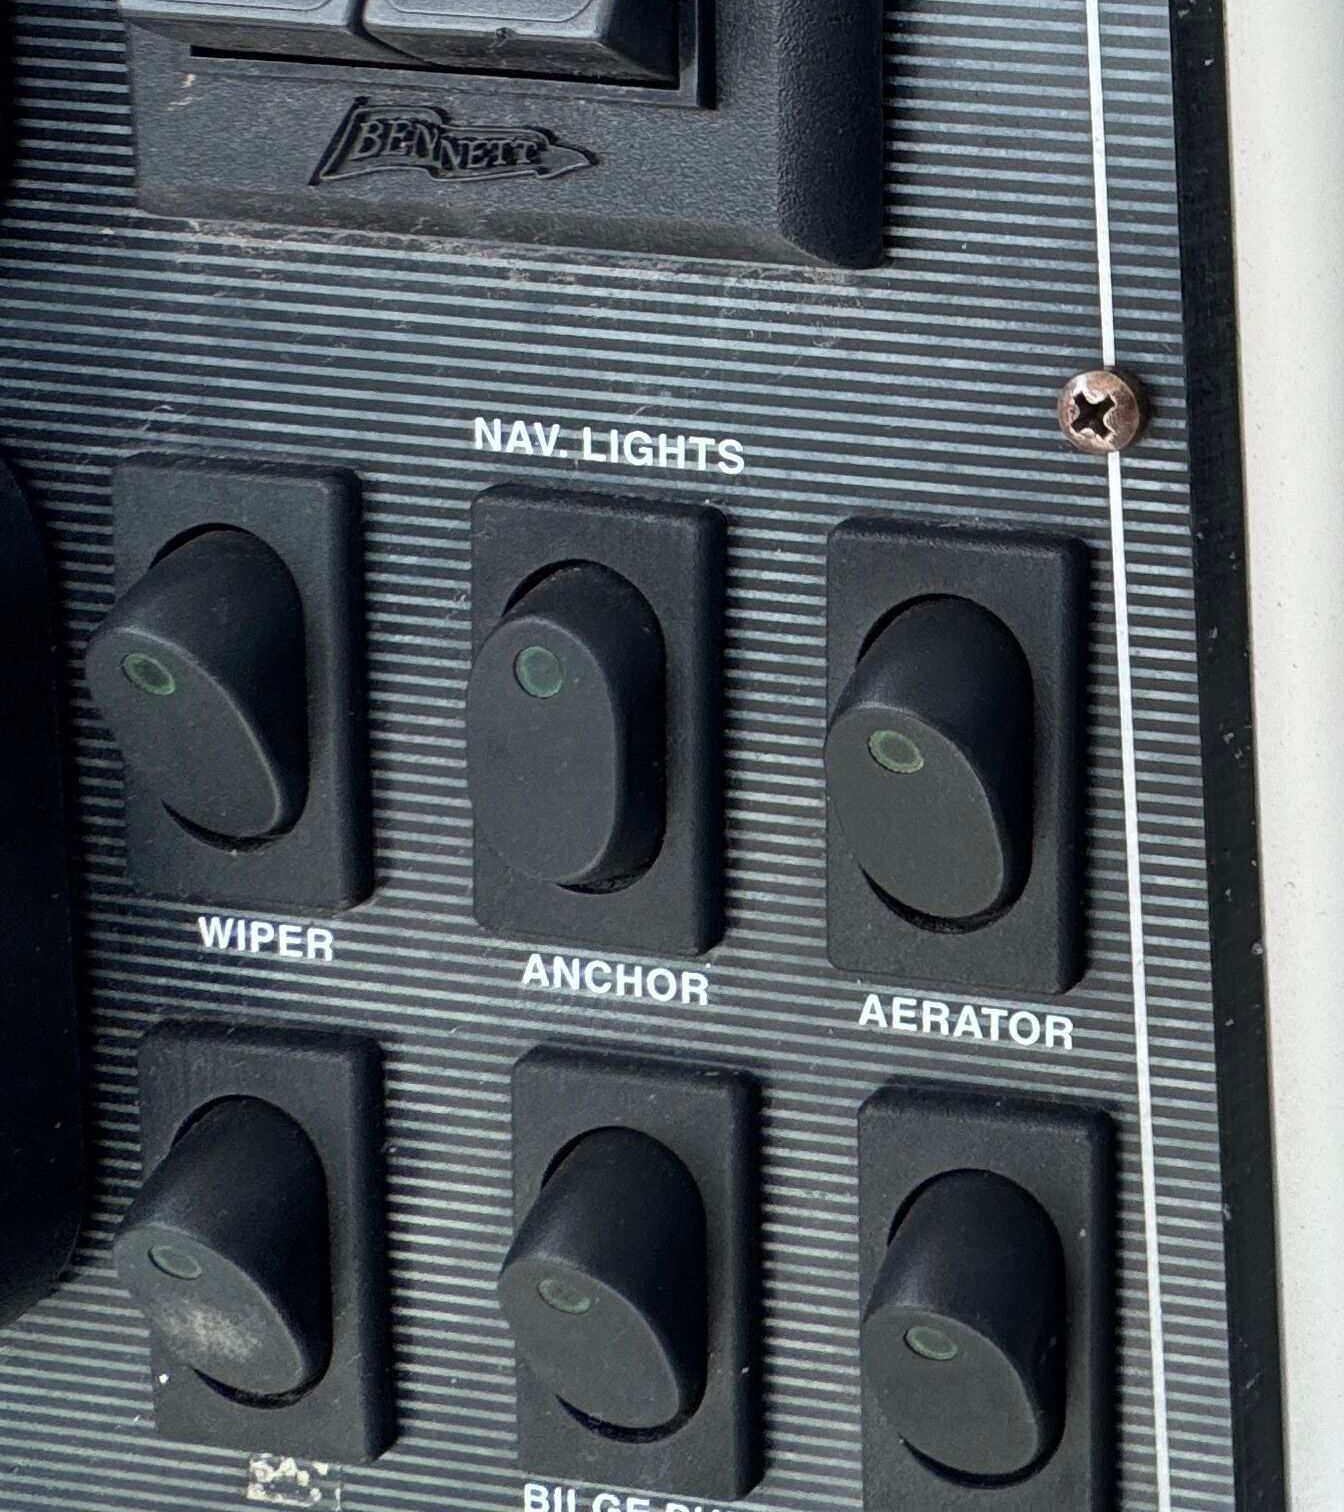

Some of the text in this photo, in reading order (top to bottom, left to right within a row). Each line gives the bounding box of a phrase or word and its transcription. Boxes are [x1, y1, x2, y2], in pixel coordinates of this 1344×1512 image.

[342, 116, 540, 172] BENNETT
[582, 425, 746, 475] LIGHTS
[198, 915, 335, 963] WIPER
[521, 952, 709, 1007] ANCHOR
[858, 993, 1074, 1051] AERATOR
